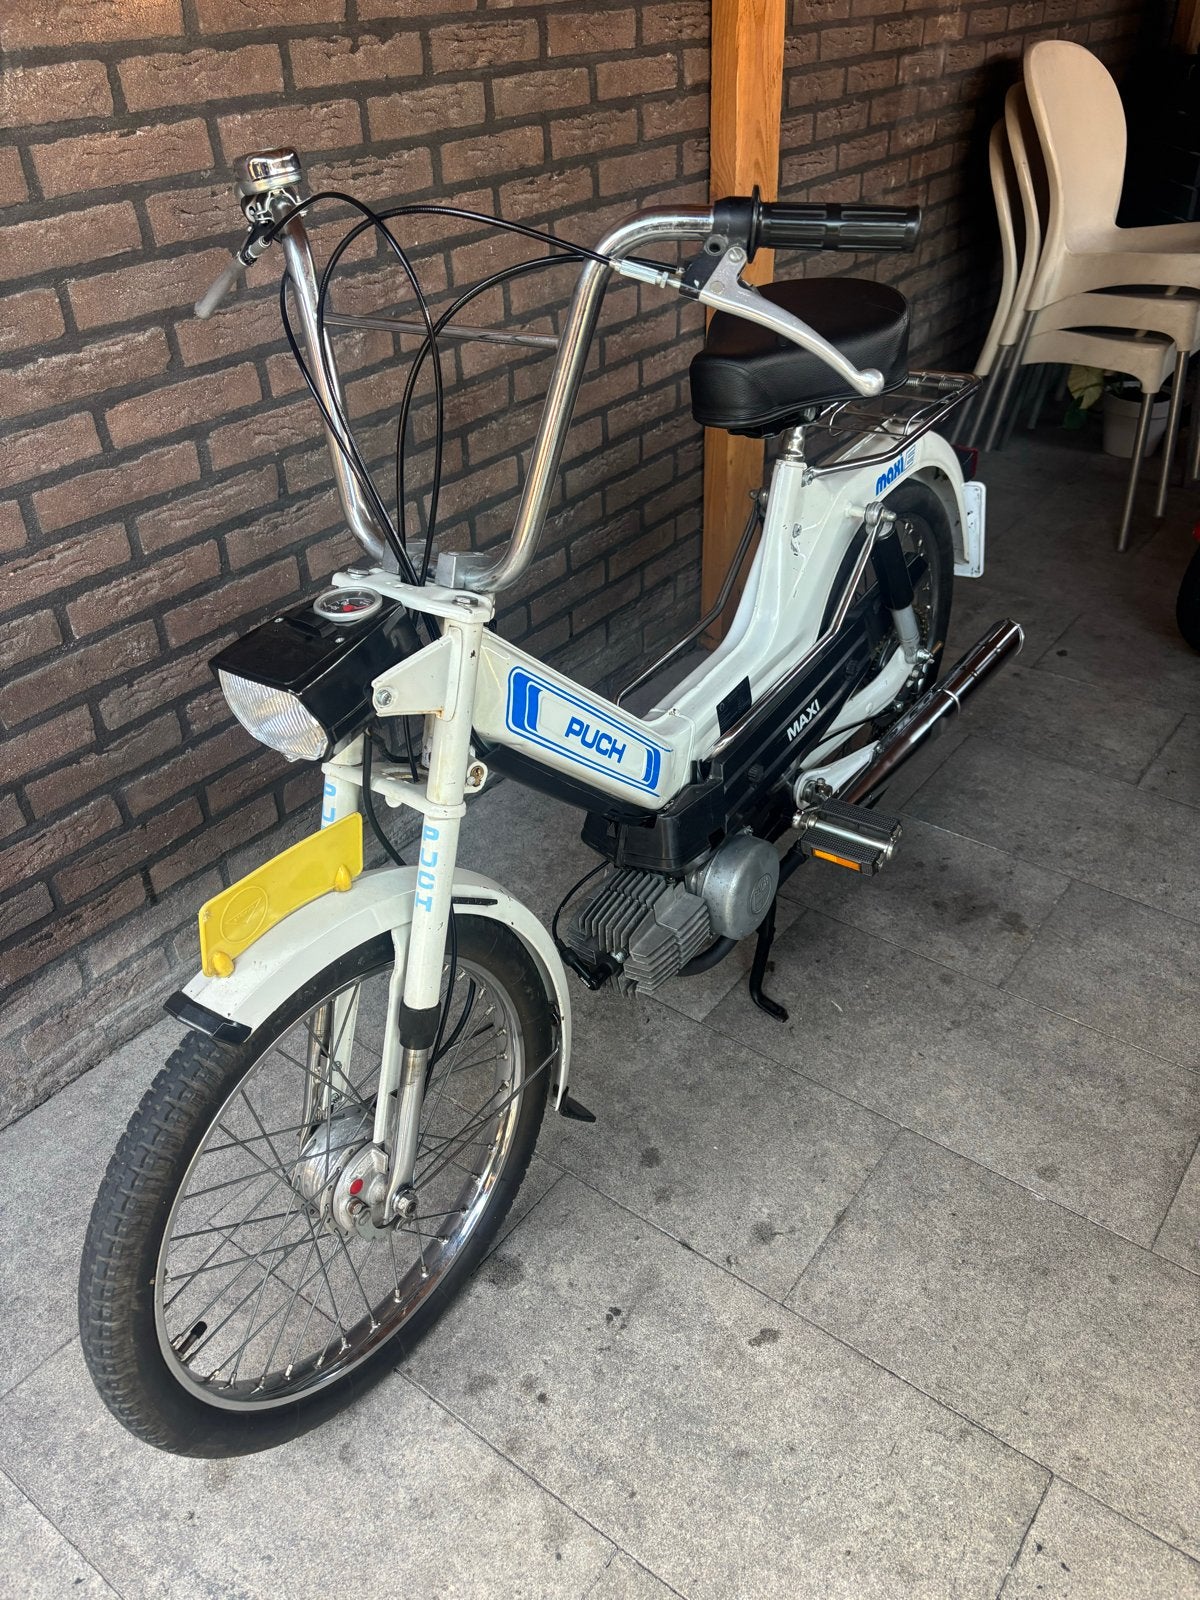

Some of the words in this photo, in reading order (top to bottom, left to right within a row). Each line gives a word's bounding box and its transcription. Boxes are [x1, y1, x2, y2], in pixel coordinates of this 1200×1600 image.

[564, 716, 627, 764] PUCH
[786, 698, 820, 742] MAXI
[321, 782, 337, 829] PU
[415, 824, 440, 912] PUCH
